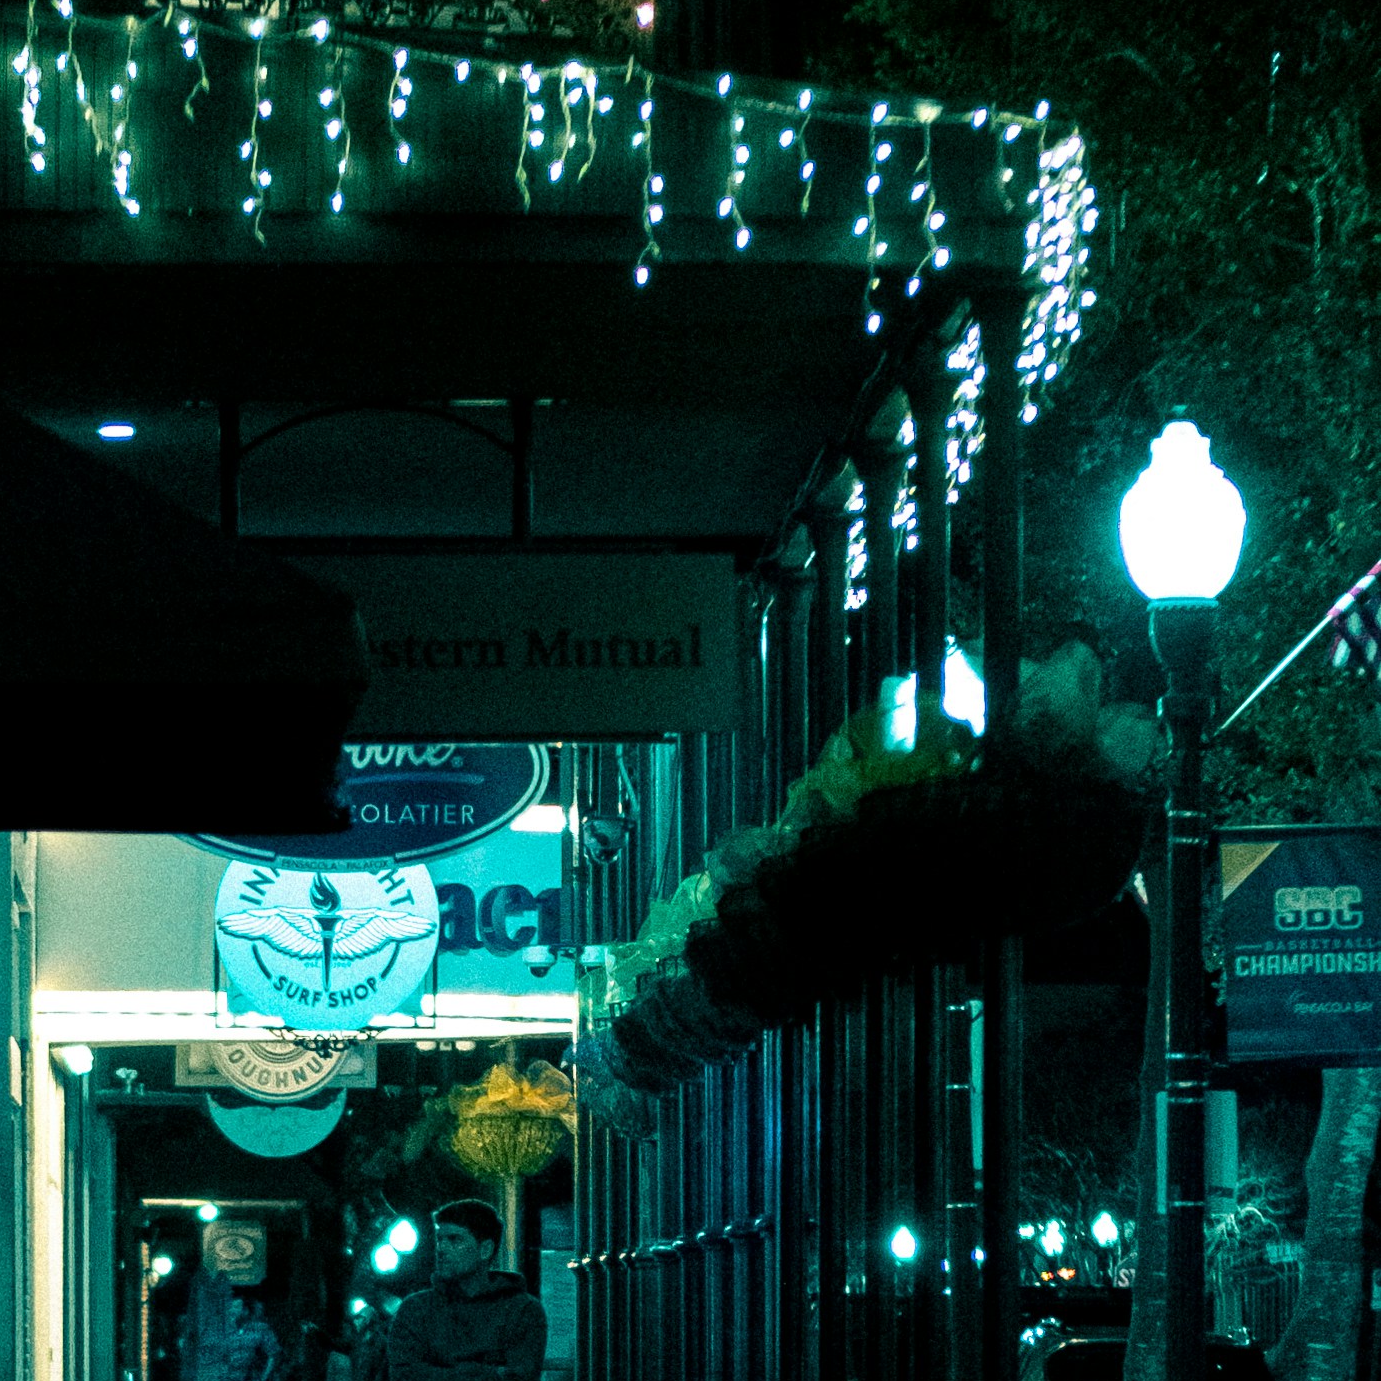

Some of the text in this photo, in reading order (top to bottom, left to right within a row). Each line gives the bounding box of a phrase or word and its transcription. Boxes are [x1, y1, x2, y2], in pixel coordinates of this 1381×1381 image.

[369, 625, 702, 668] stern Mutual
[350, 803, 476, 825] OLATIER
[1274, 885, 1364, 932] SBC
[272, 976, 379, 1008] SURF SHOP
[223, 1041, 330, 1089] OUGHNU
